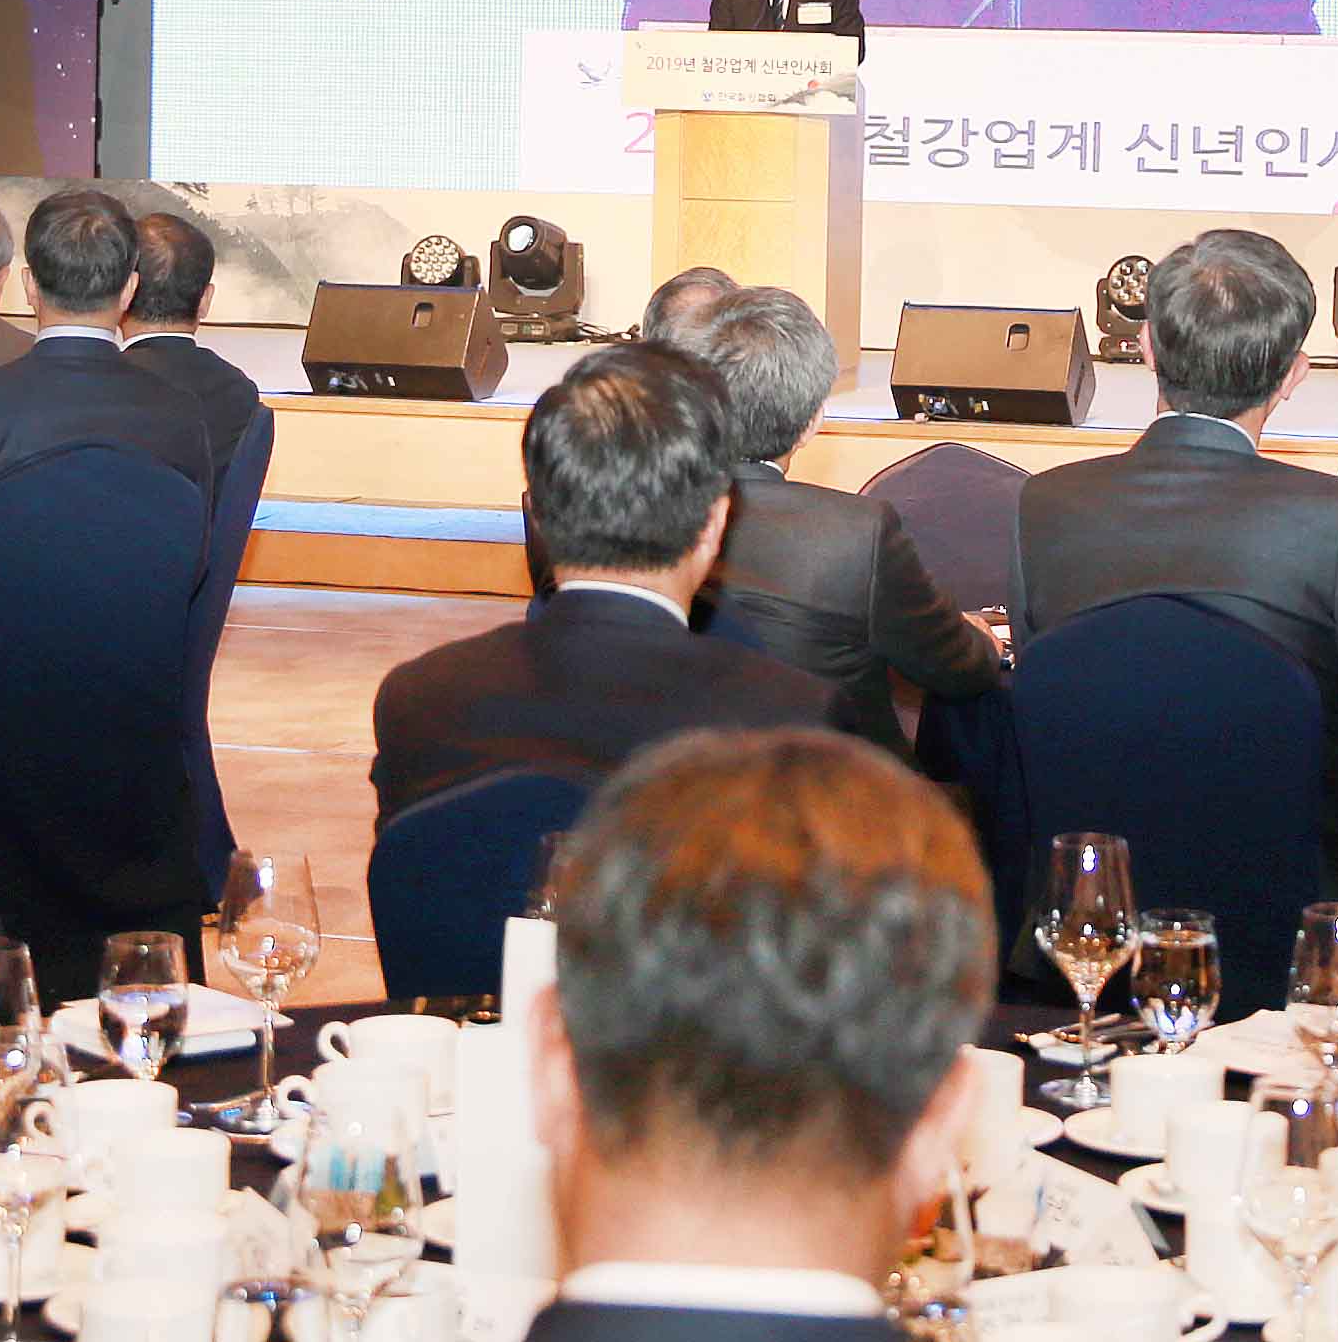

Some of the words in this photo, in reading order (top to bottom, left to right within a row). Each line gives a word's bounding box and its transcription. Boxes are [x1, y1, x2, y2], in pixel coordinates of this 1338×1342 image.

[646, 56, 696, 73] 2019년
[702, 58, 757, 74] 철강업계
[762, 59, 833, 76] 신년인사회
[863, 115, 1102, 173] 철강업계
